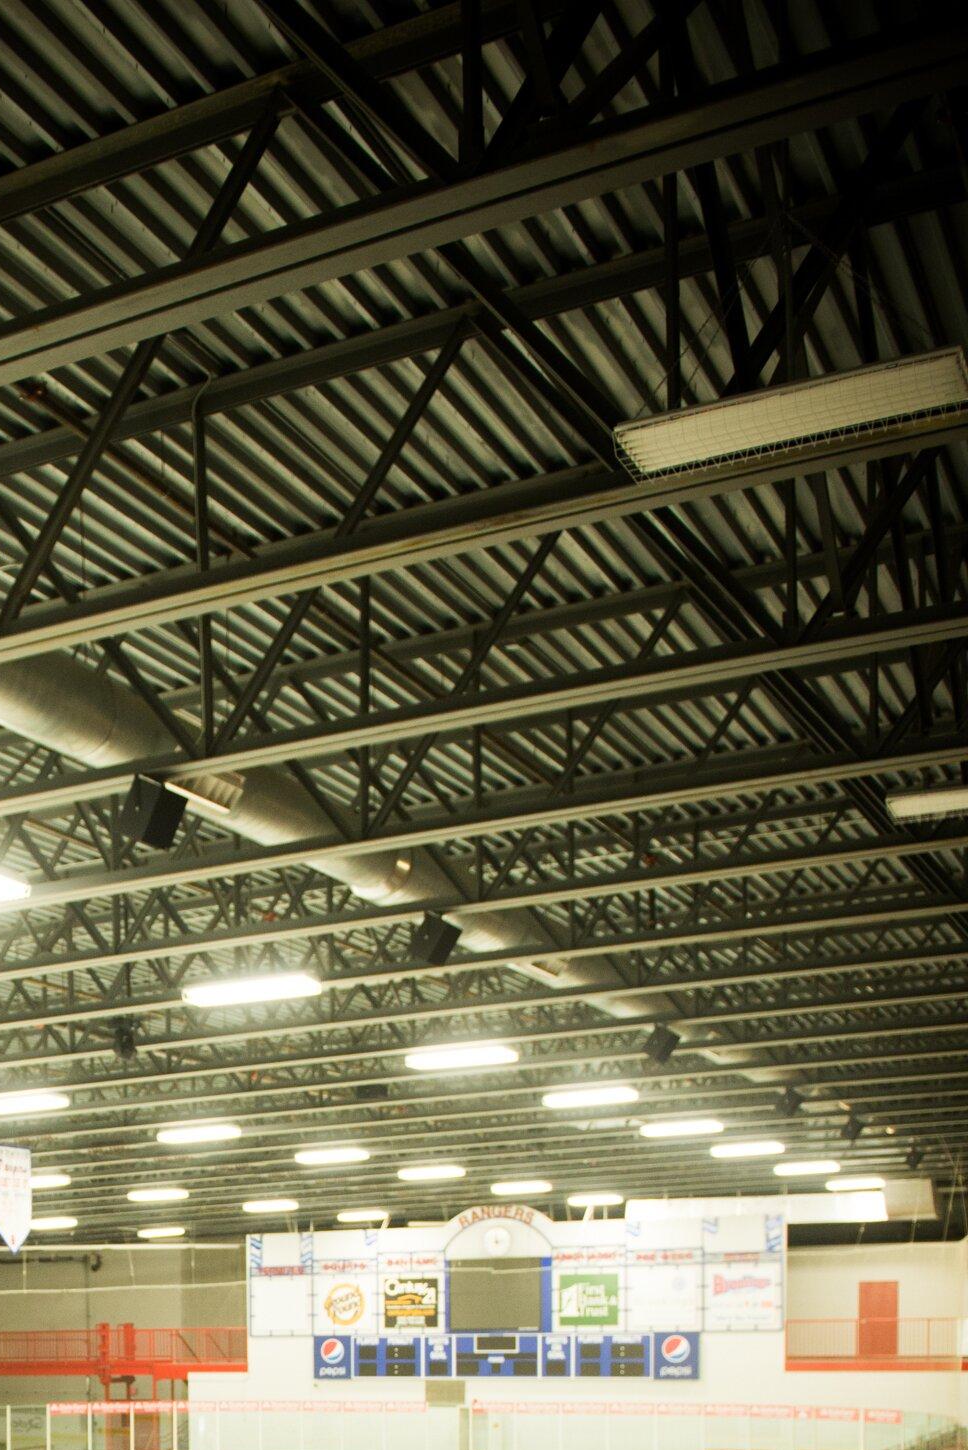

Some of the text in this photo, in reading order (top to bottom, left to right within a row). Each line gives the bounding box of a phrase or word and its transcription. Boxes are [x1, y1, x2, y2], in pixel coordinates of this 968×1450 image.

[457, 1204, 534, 1228] RANGERS
[319, 1366, 346, 1377] pepsi
[659, 1364, 693, 1378] pepsi
